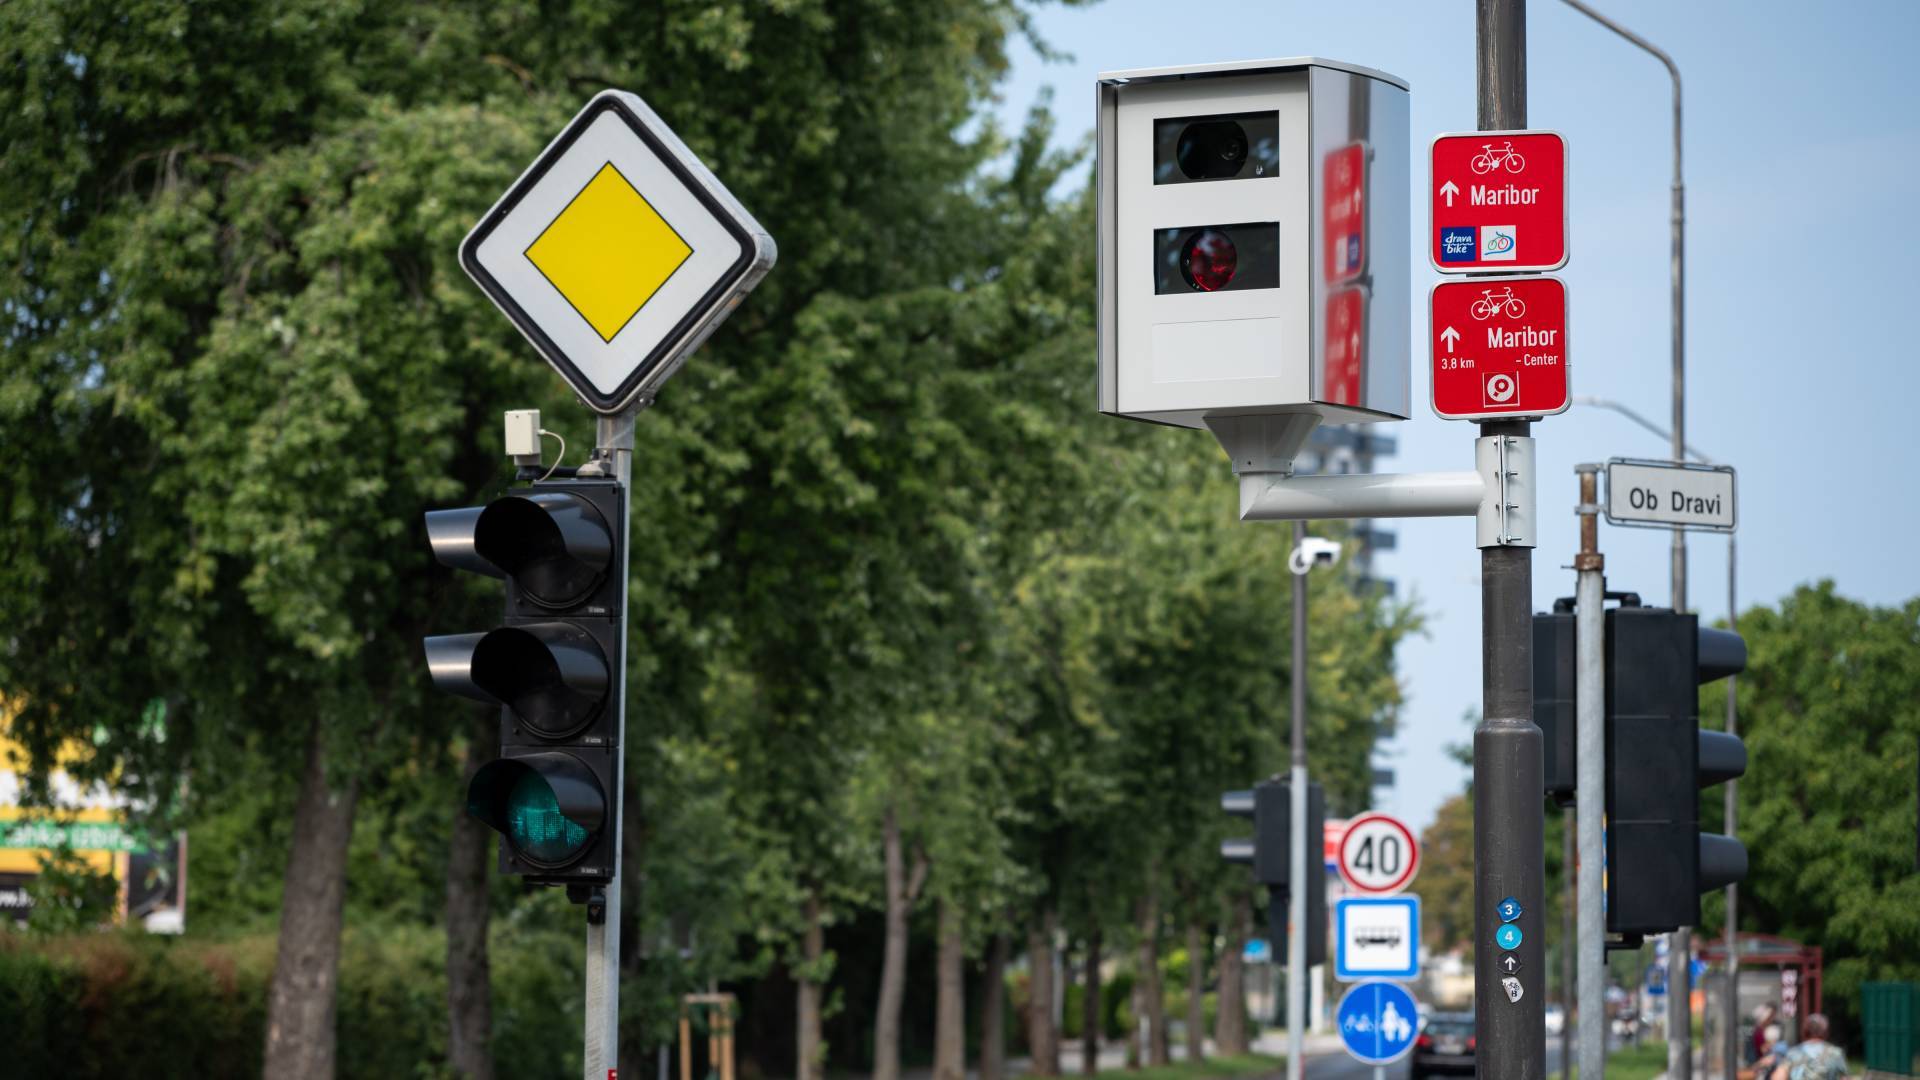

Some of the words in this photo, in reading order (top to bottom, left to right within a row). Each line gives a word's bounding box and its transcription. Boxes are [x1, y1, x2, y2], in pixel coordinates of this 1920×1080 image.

[1471, 184, 1540, 206] Maribor
[1445, 232, 1472, 244] drava
[1446, 243, 1467, 254] bike
[1487, 326, 1557, 349] Maribor
[1460, 357, 1475, 369] km
[1629, 487, 1658, 511] Ob
[1671, 491, 1721, 515] Dravi
[1353, 835, 1400, 876] 40
[1504, 904, 1513, 916] 3
[1504, 930, 1514, 942] 4
